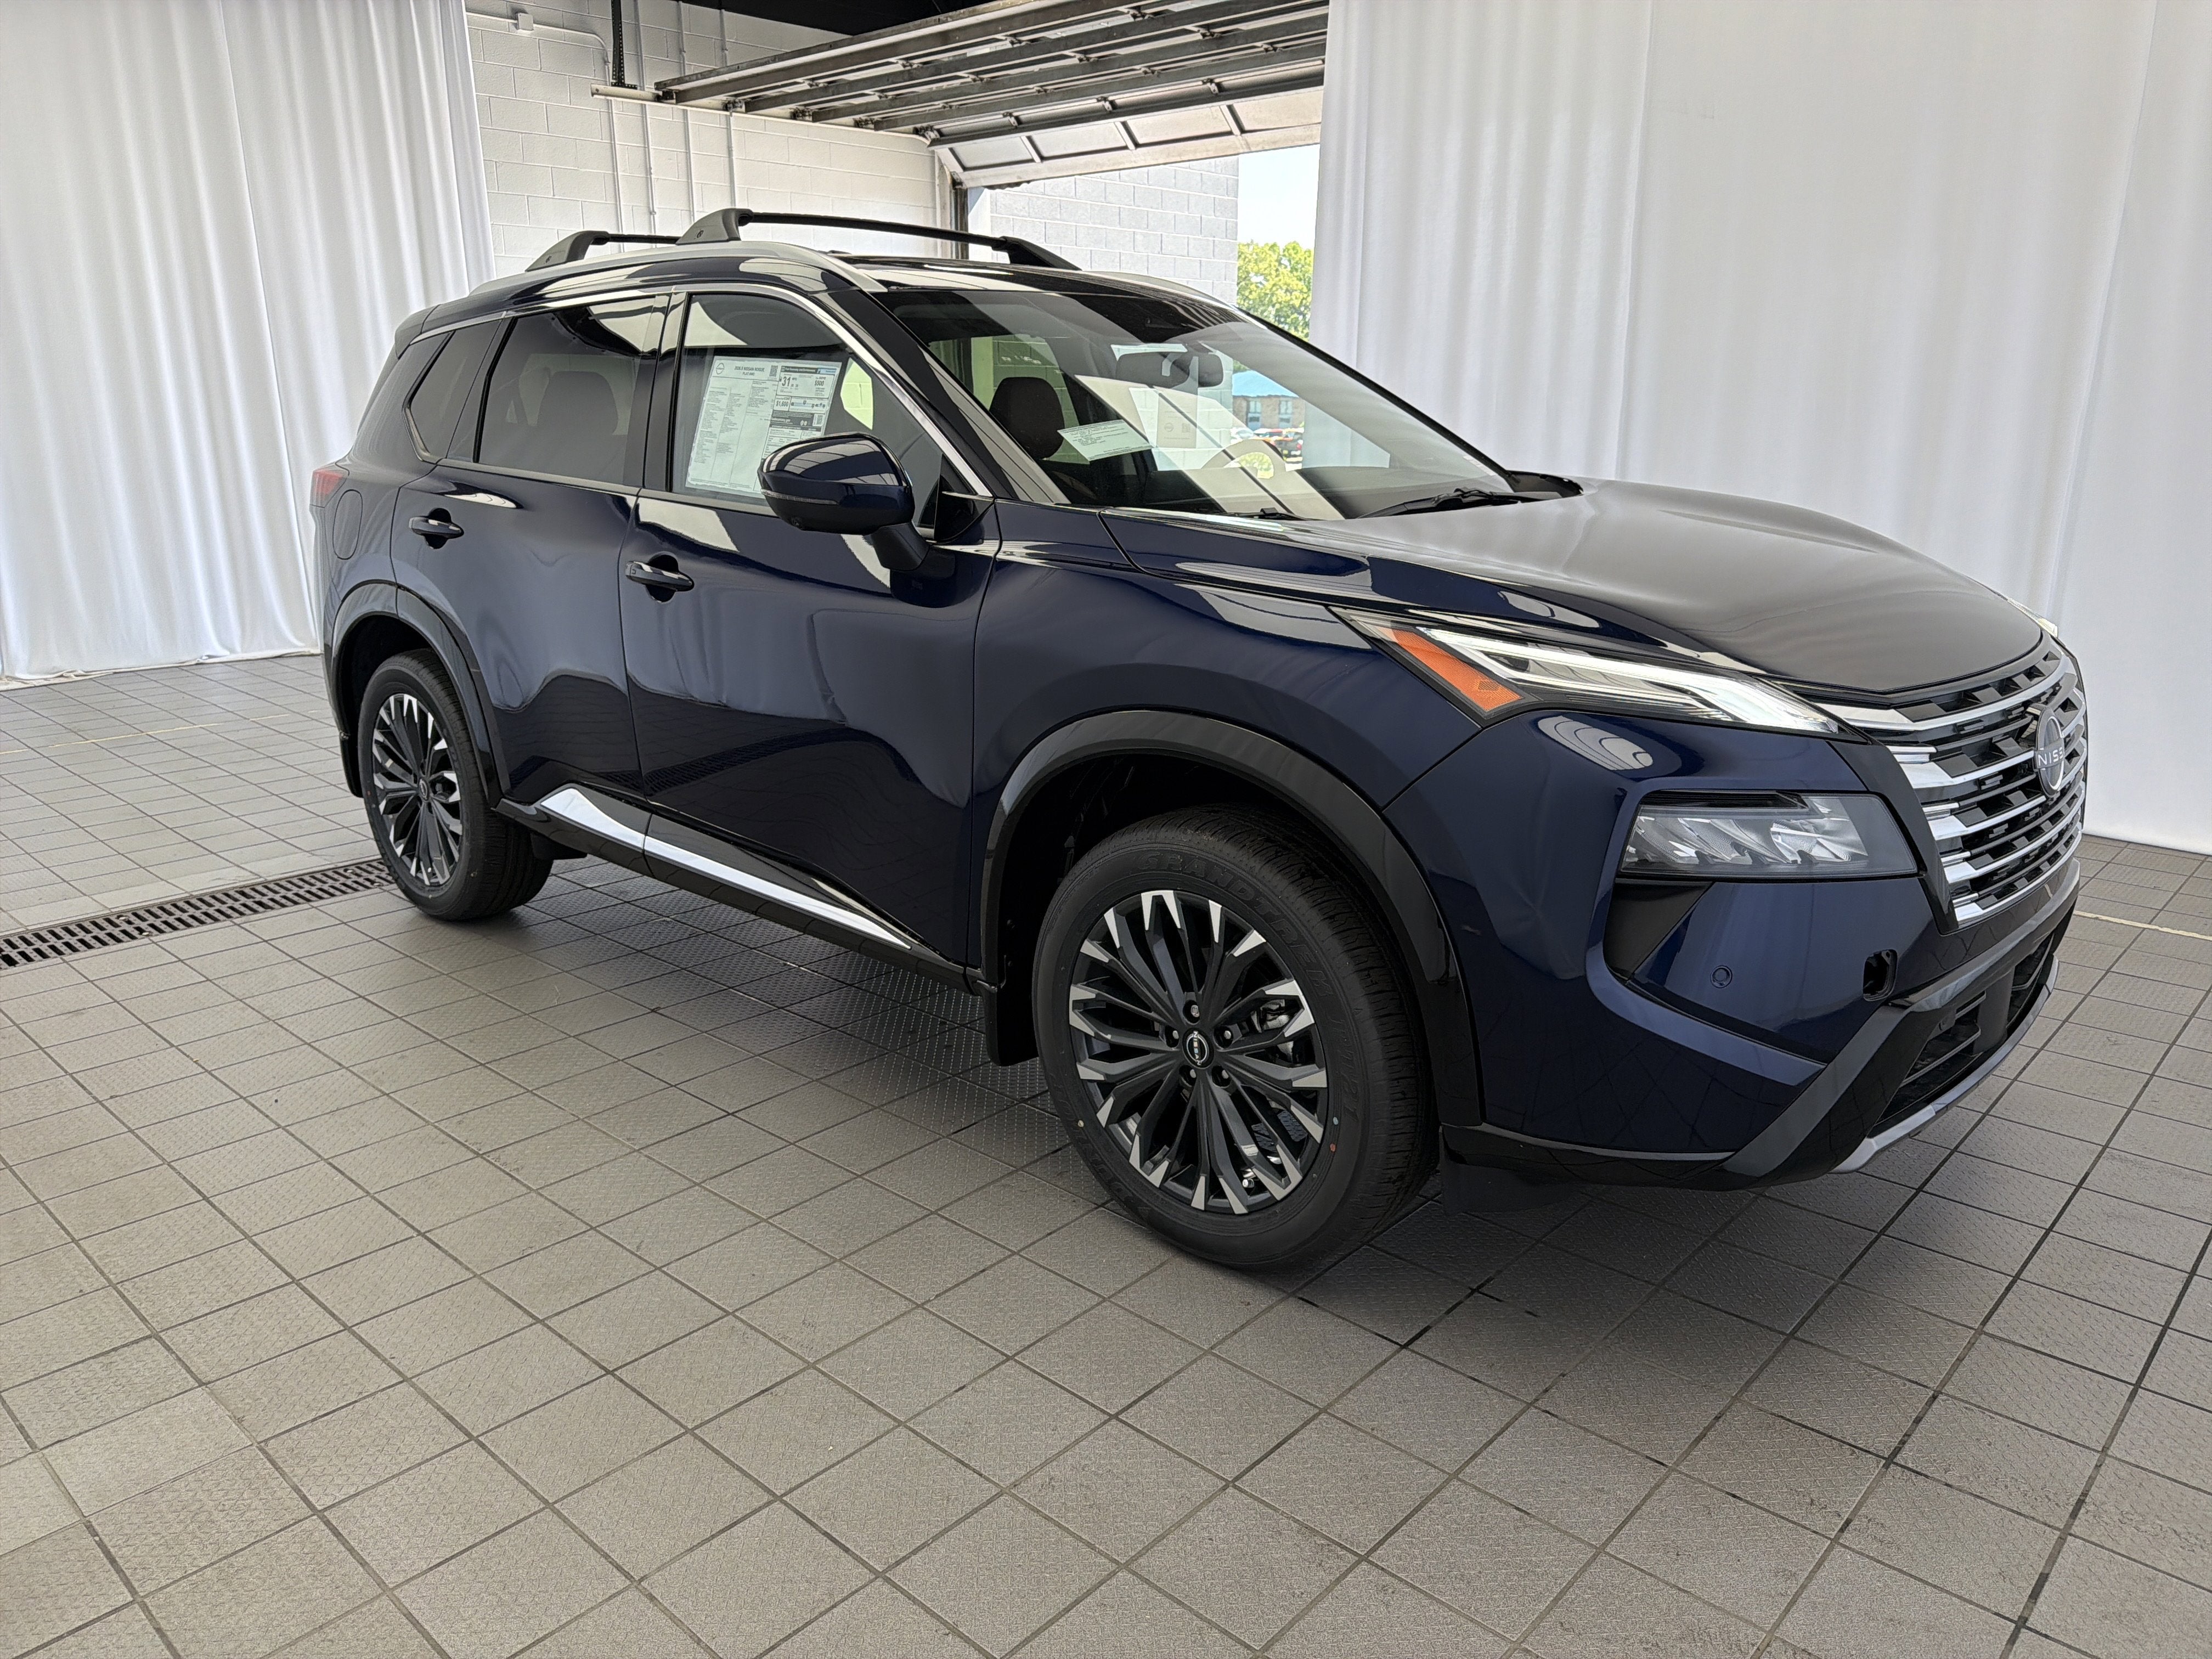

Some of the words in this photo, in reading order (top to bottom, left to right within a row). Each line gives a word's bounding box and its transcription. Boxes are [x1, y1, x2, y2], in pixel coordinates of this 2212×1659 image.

[782, 376, 791, 387] 31
[2038, 747, 2063, 766] NISS
[1138, 850, 1334, 997] GRANDTREK
[1193, 1030, 1201, 1066] NISSAN
